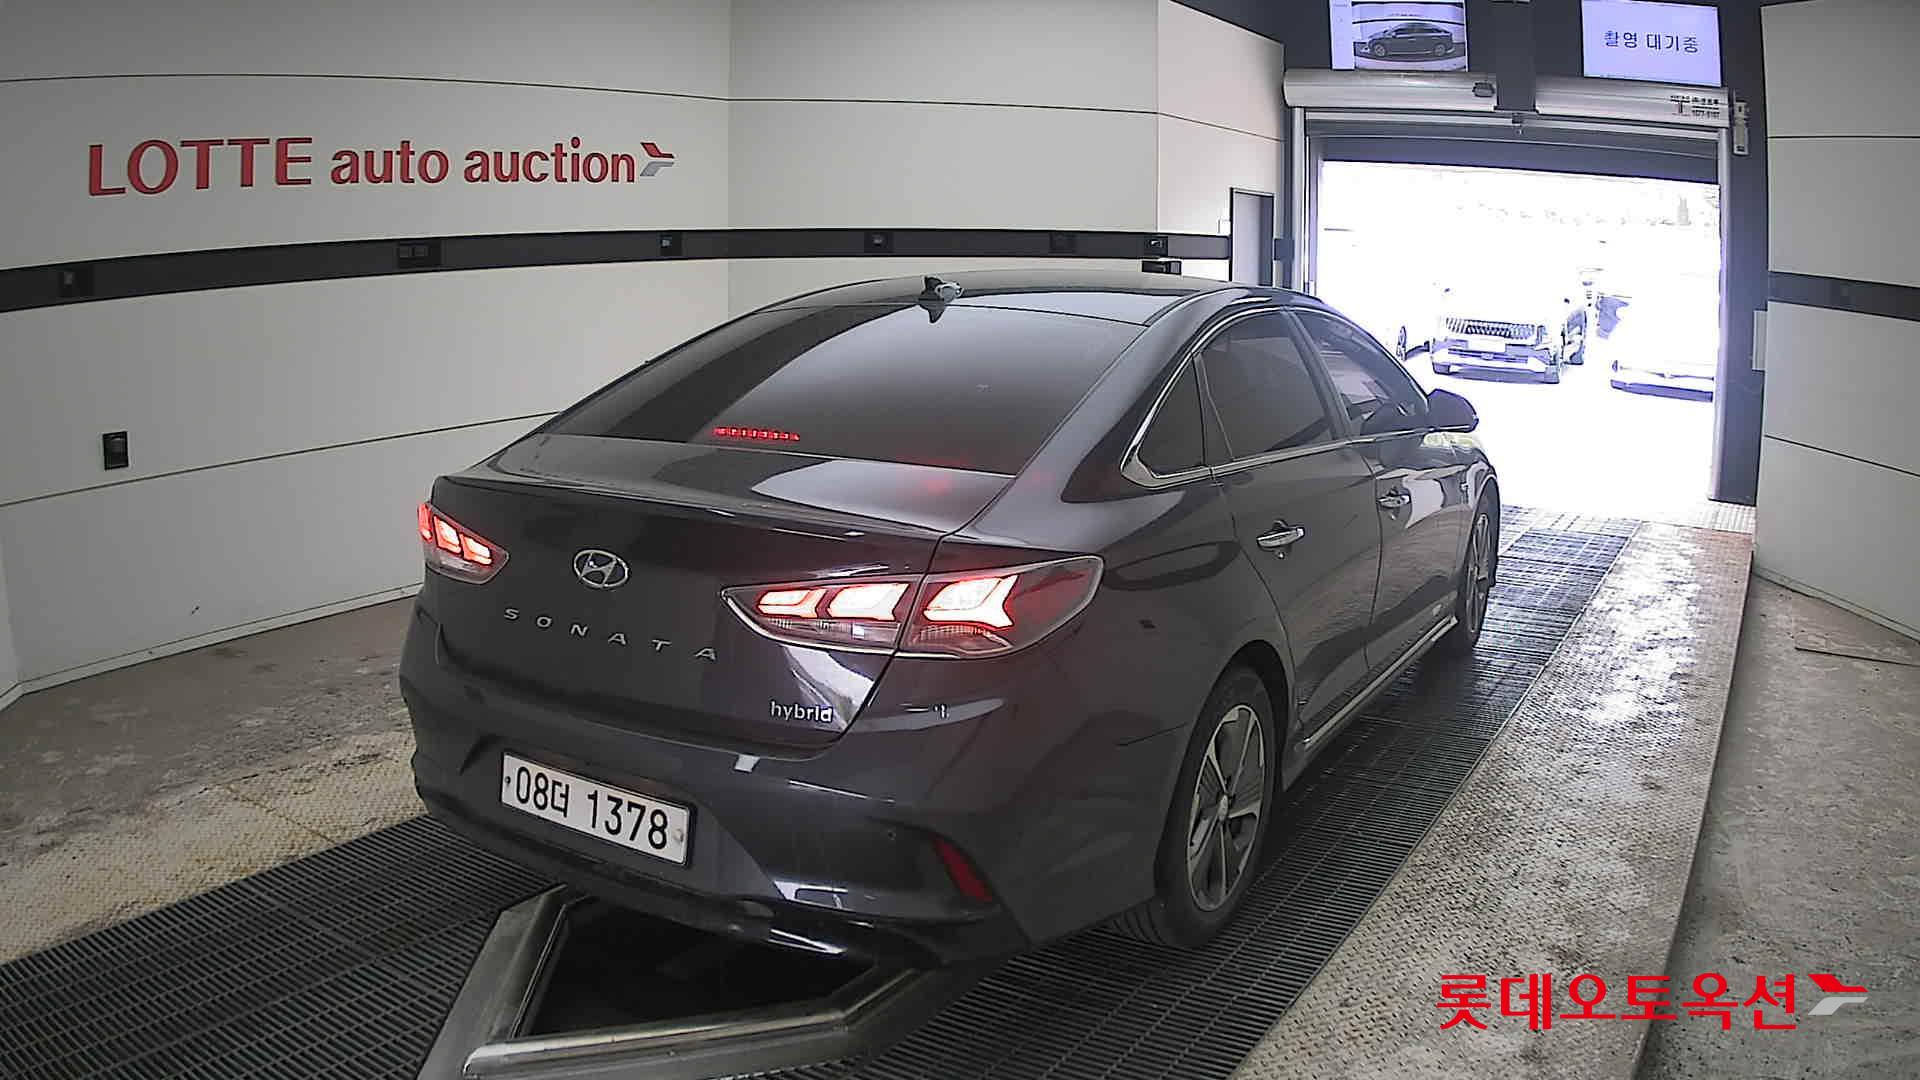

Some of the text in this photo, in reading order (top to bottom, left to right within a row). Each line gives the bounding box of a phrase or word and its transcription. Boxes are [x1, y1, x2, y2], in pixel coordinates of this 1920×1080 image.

[1646, 32, 1699, 54] 대기중
[89, 137, 637, 195] LOTTE auto auction
[503, 607, 718, 661] SONATA
[770, 700, 834, 723] hybrid
[516, 766, 668, 850] 08더 1378
